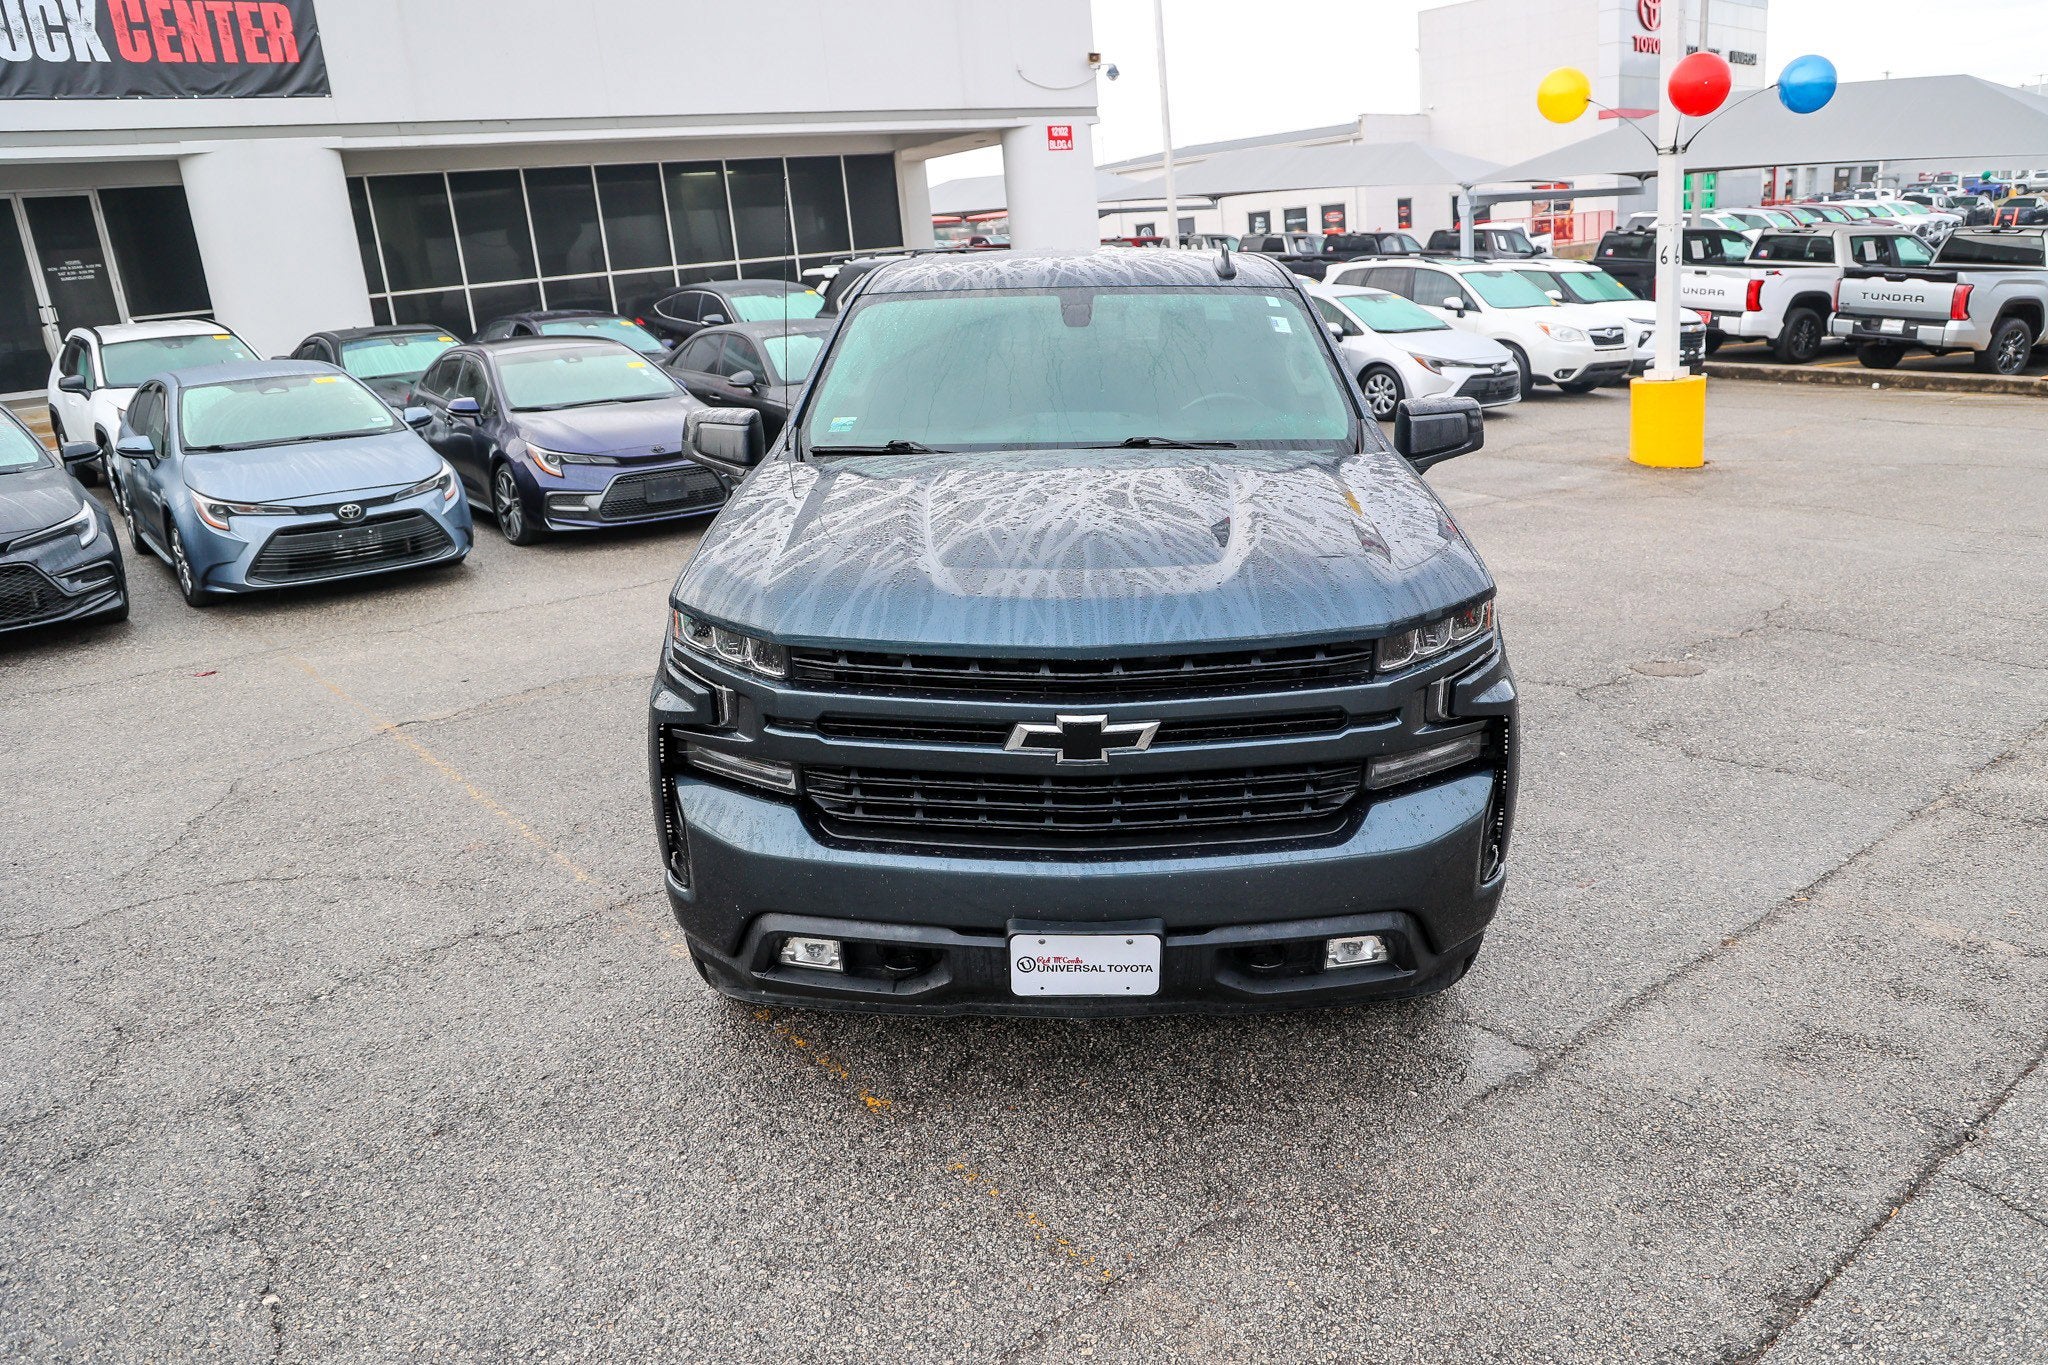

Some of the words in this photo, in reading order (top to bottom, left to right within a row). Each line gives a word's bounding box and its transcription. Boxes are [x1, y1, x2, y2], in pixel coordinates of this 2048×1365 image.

[107, 0, 300, 63] CENTER
[1660, 245, 1668, 265] 6
[1861, 291, 1925, 303] TUNDRA
[1036, 956, 1051, 967] Red
[1037, 964, 1106, 973] UNIVERSAL
[1107, 964, 1154, 973] TOYOTA
